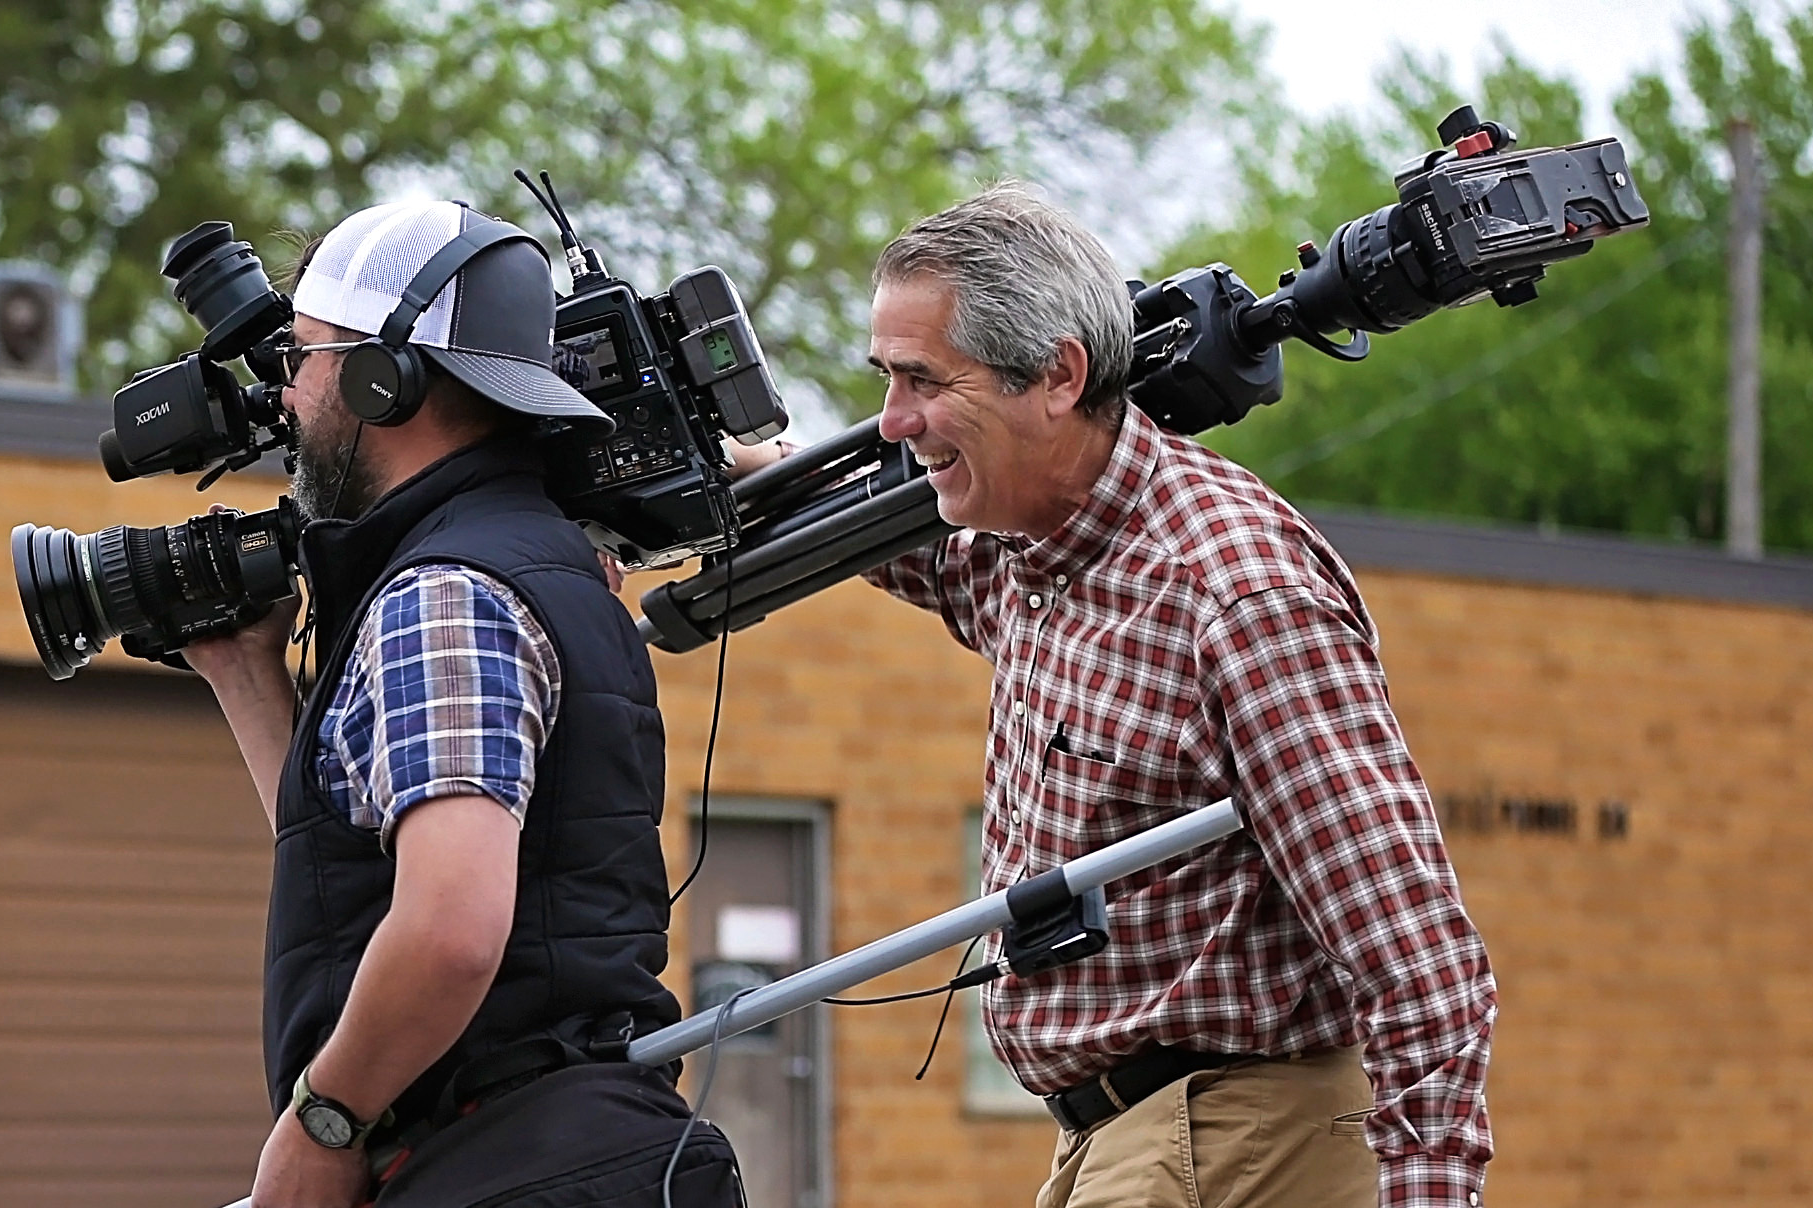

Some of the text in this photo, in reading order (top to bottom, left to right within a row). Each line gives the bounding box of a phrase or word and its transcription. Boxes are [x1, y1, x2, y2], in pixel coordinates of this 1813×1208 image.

[1421, 203, 1446, 251] sachtler
[371, 382, 393, 399] SONY
[135, 401, 170, 427] XDCAM
